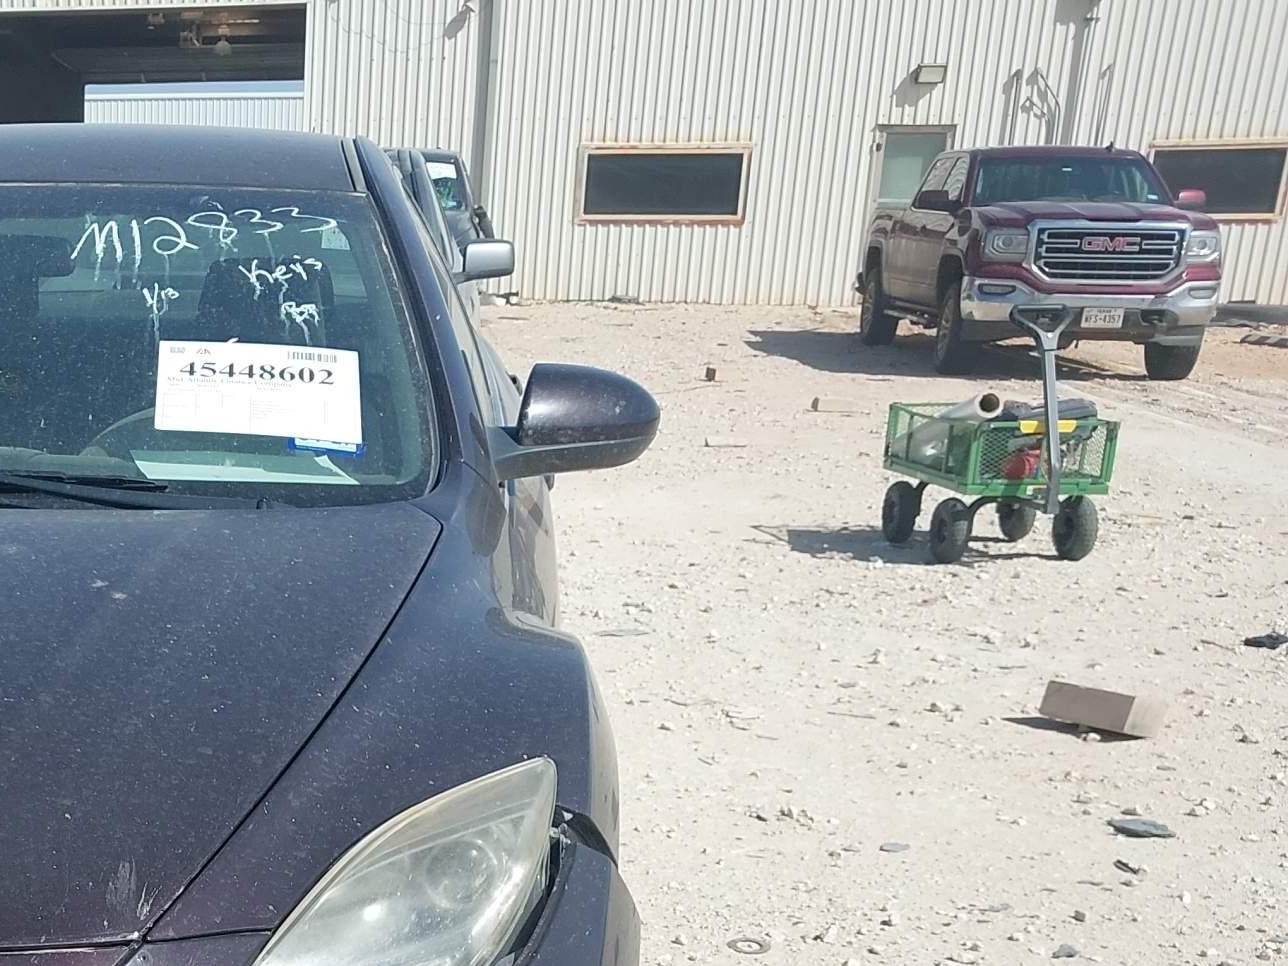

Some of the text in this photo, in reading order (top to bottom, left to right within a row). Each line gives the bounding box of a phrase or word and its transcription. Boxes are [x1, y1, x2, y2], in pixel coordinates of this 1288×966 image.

[71, 207, 338, 266] M12833
[1081, 236, 1141, 252] GMC
[179, 361, 335, 385] 45448602
